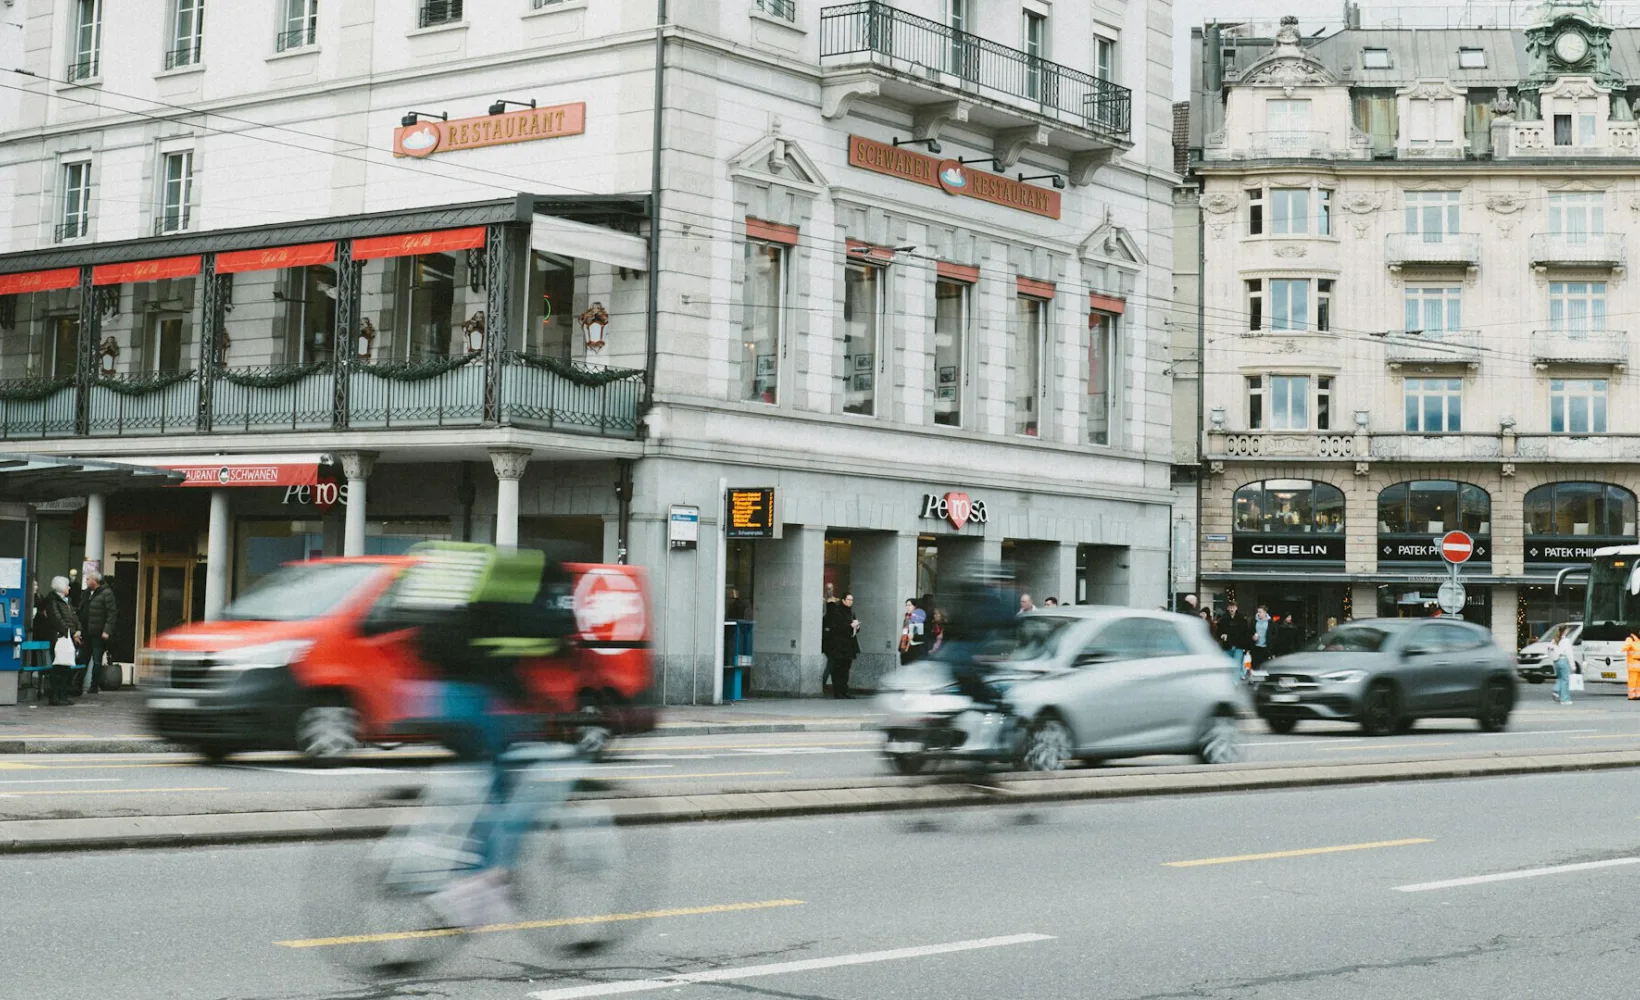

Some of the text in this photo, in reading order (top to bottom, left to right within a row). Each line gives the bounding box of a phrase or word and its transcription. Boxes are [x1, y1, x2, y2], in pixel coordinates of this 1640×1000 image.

[448, 110, 565, 146] RESTAURANT
[857, 142, 1050, 212] SCHWANEN RESTAURANT
[229, 468, 279, 481] SCHWANEN
[281, 482, 348, 505] Peros
[922, 494, 989, 523] Perosa
[1251, 544, 1327, 555] GÜBELIN
[1398, 545, 1427, 556] PATEK
[1544, 547, 1574, 558] PATEK
